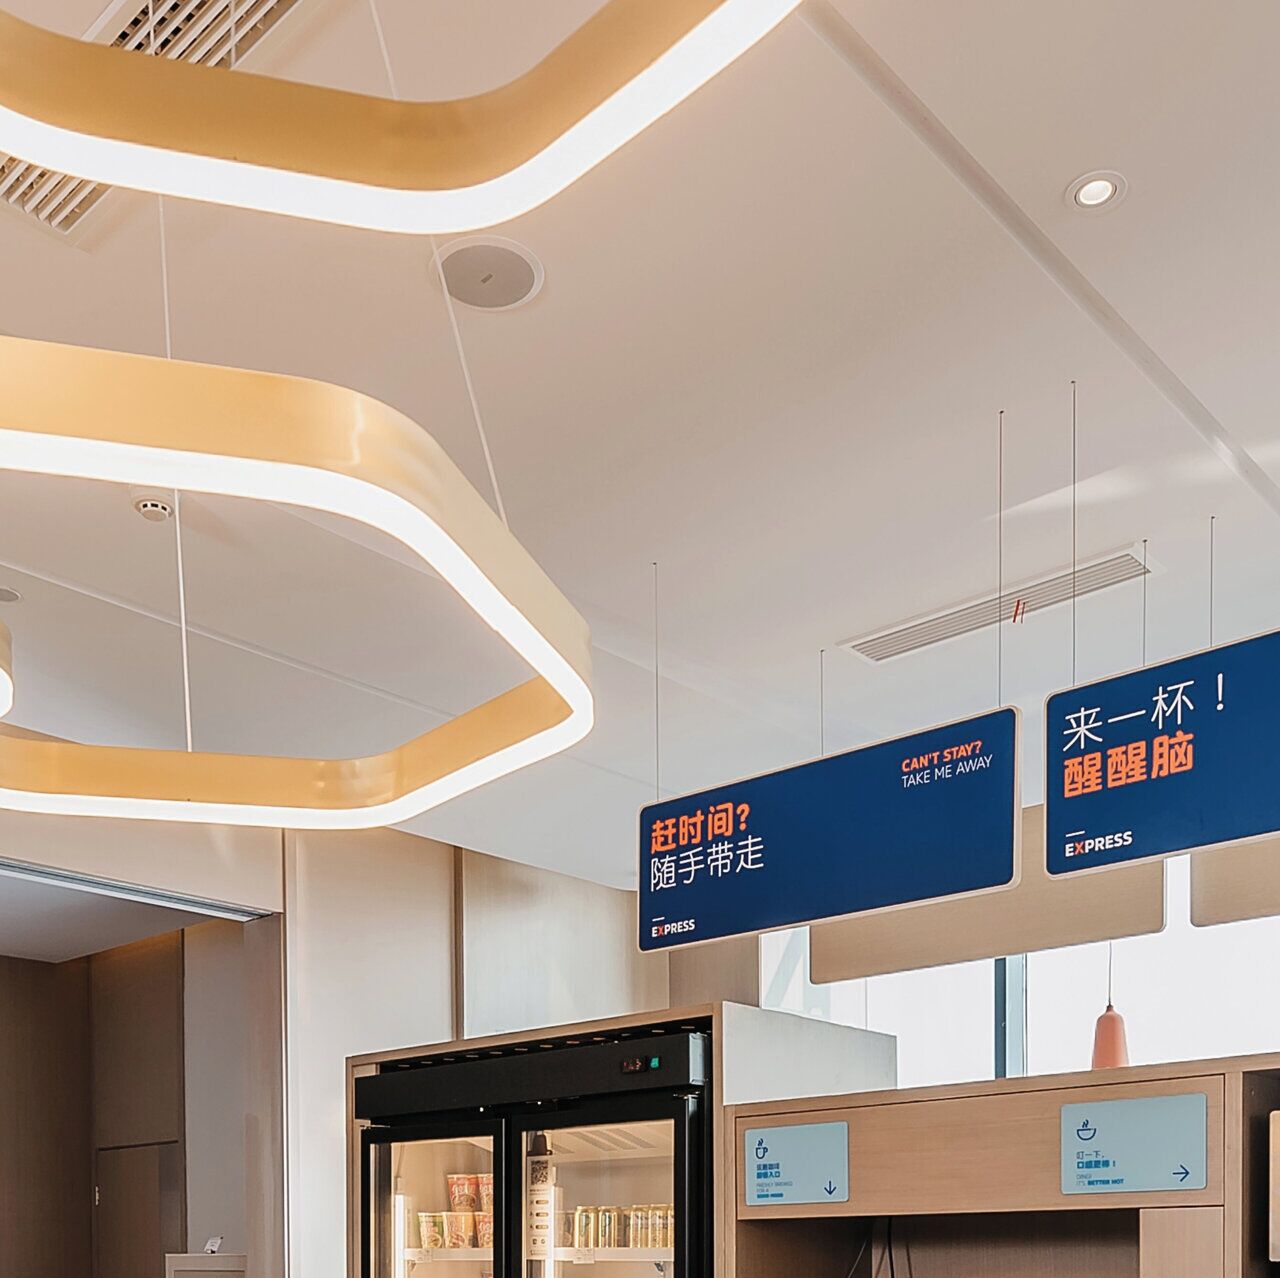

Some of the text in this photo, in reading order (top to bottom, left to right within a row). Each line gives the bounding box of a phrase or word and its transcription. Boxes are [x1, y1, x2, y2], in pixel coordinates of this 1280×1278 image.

[1063, 673, 1224, 752] 来一杯！
[902, 741, 982, 772] CAN'T STAY?
[902, 754, 993, 788] TAKE ME AWAY
[1063, 730, 1194, 798] 醒醒脑
[651, 802, 750, 854] 赶时间?
[1065, 831, 1133, 857] EXPRESS
[651, 835, 764, 892] 随手带走
[651, 919, 695, 937] EXPRESS
